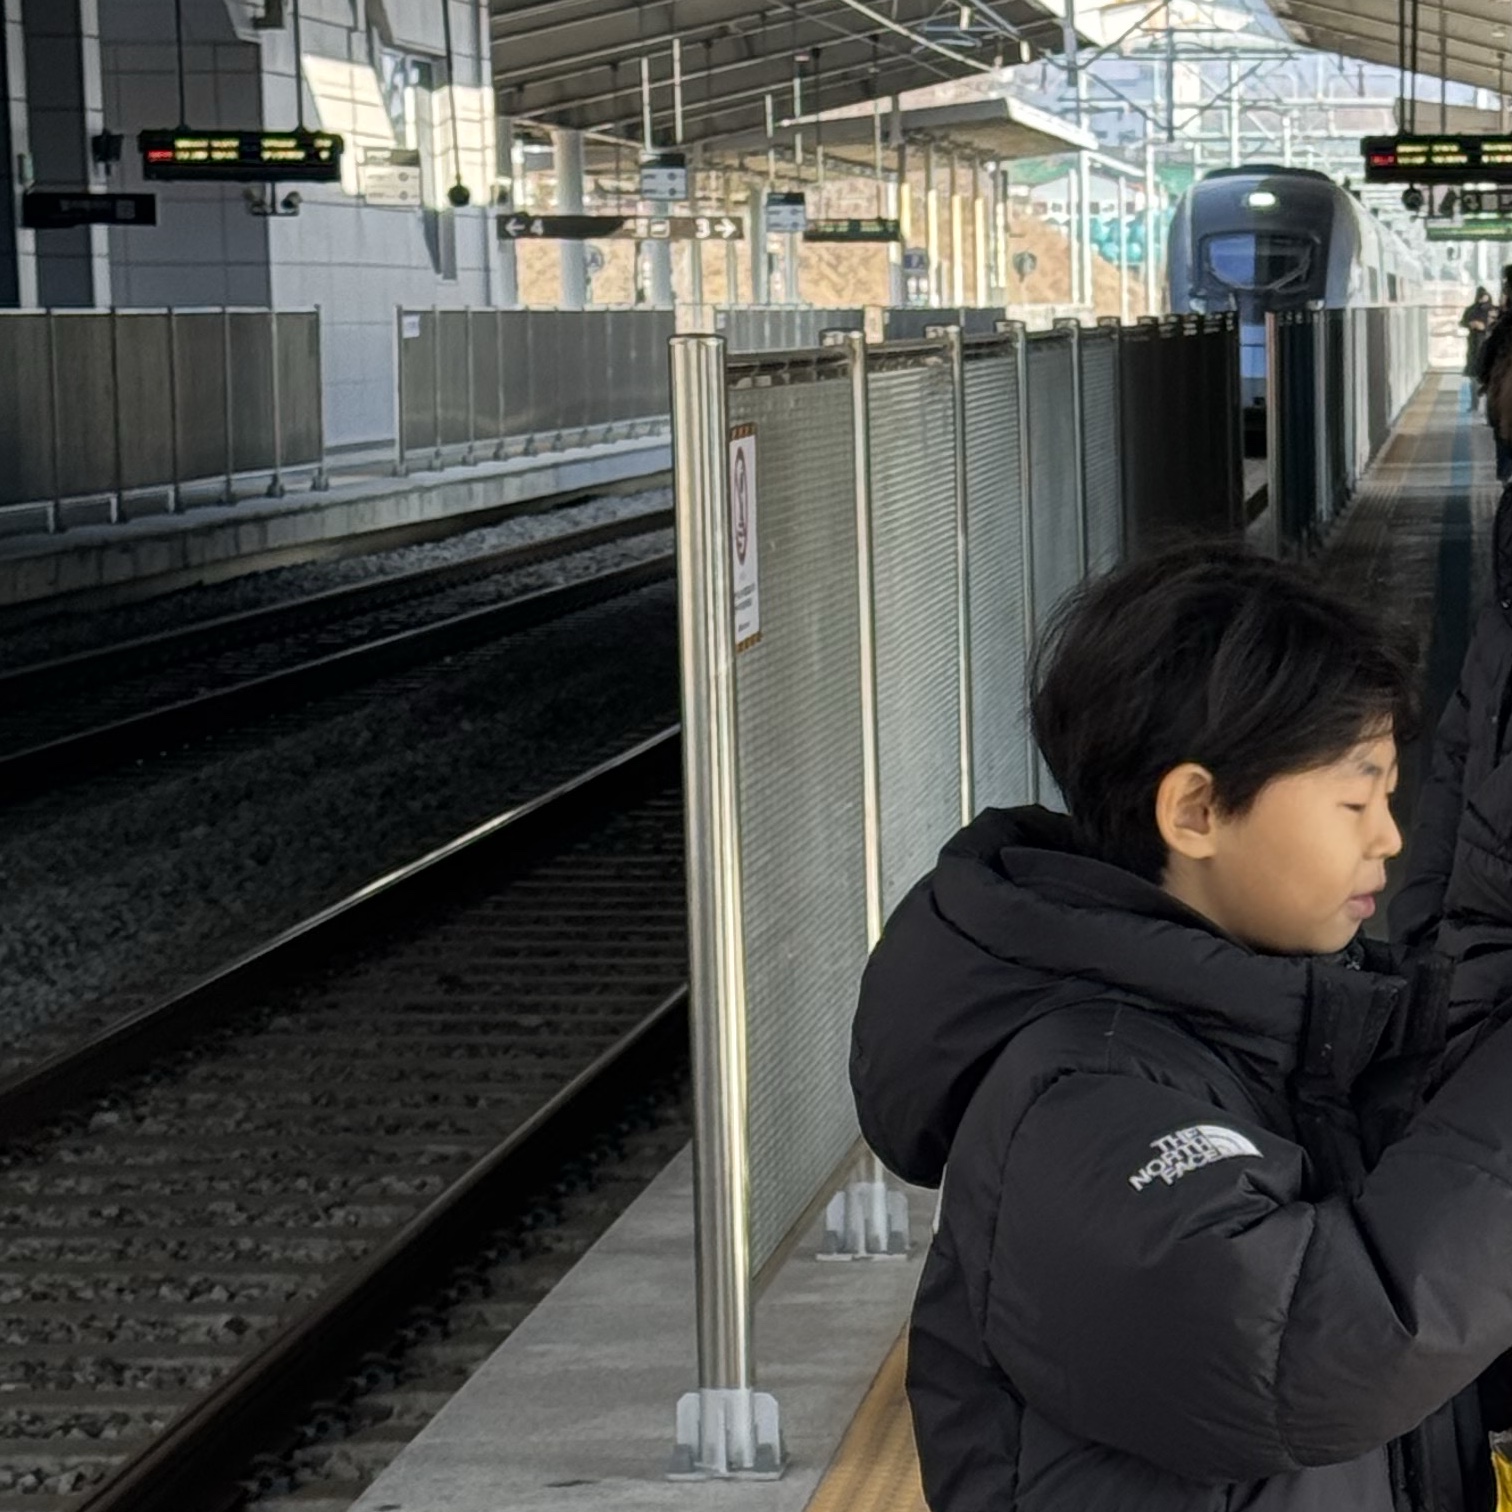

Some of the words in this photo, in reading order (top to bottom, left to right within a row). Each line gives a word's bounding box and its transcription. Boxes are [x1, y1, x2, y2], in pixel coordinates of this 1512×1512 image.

[695, 219, 711, 238] 3
[1150, 1126, 1200, 1152] THE
[1129, 1136, 1216, 1191] NORTH
[1161, 1150, 1222, 1185] FACE
